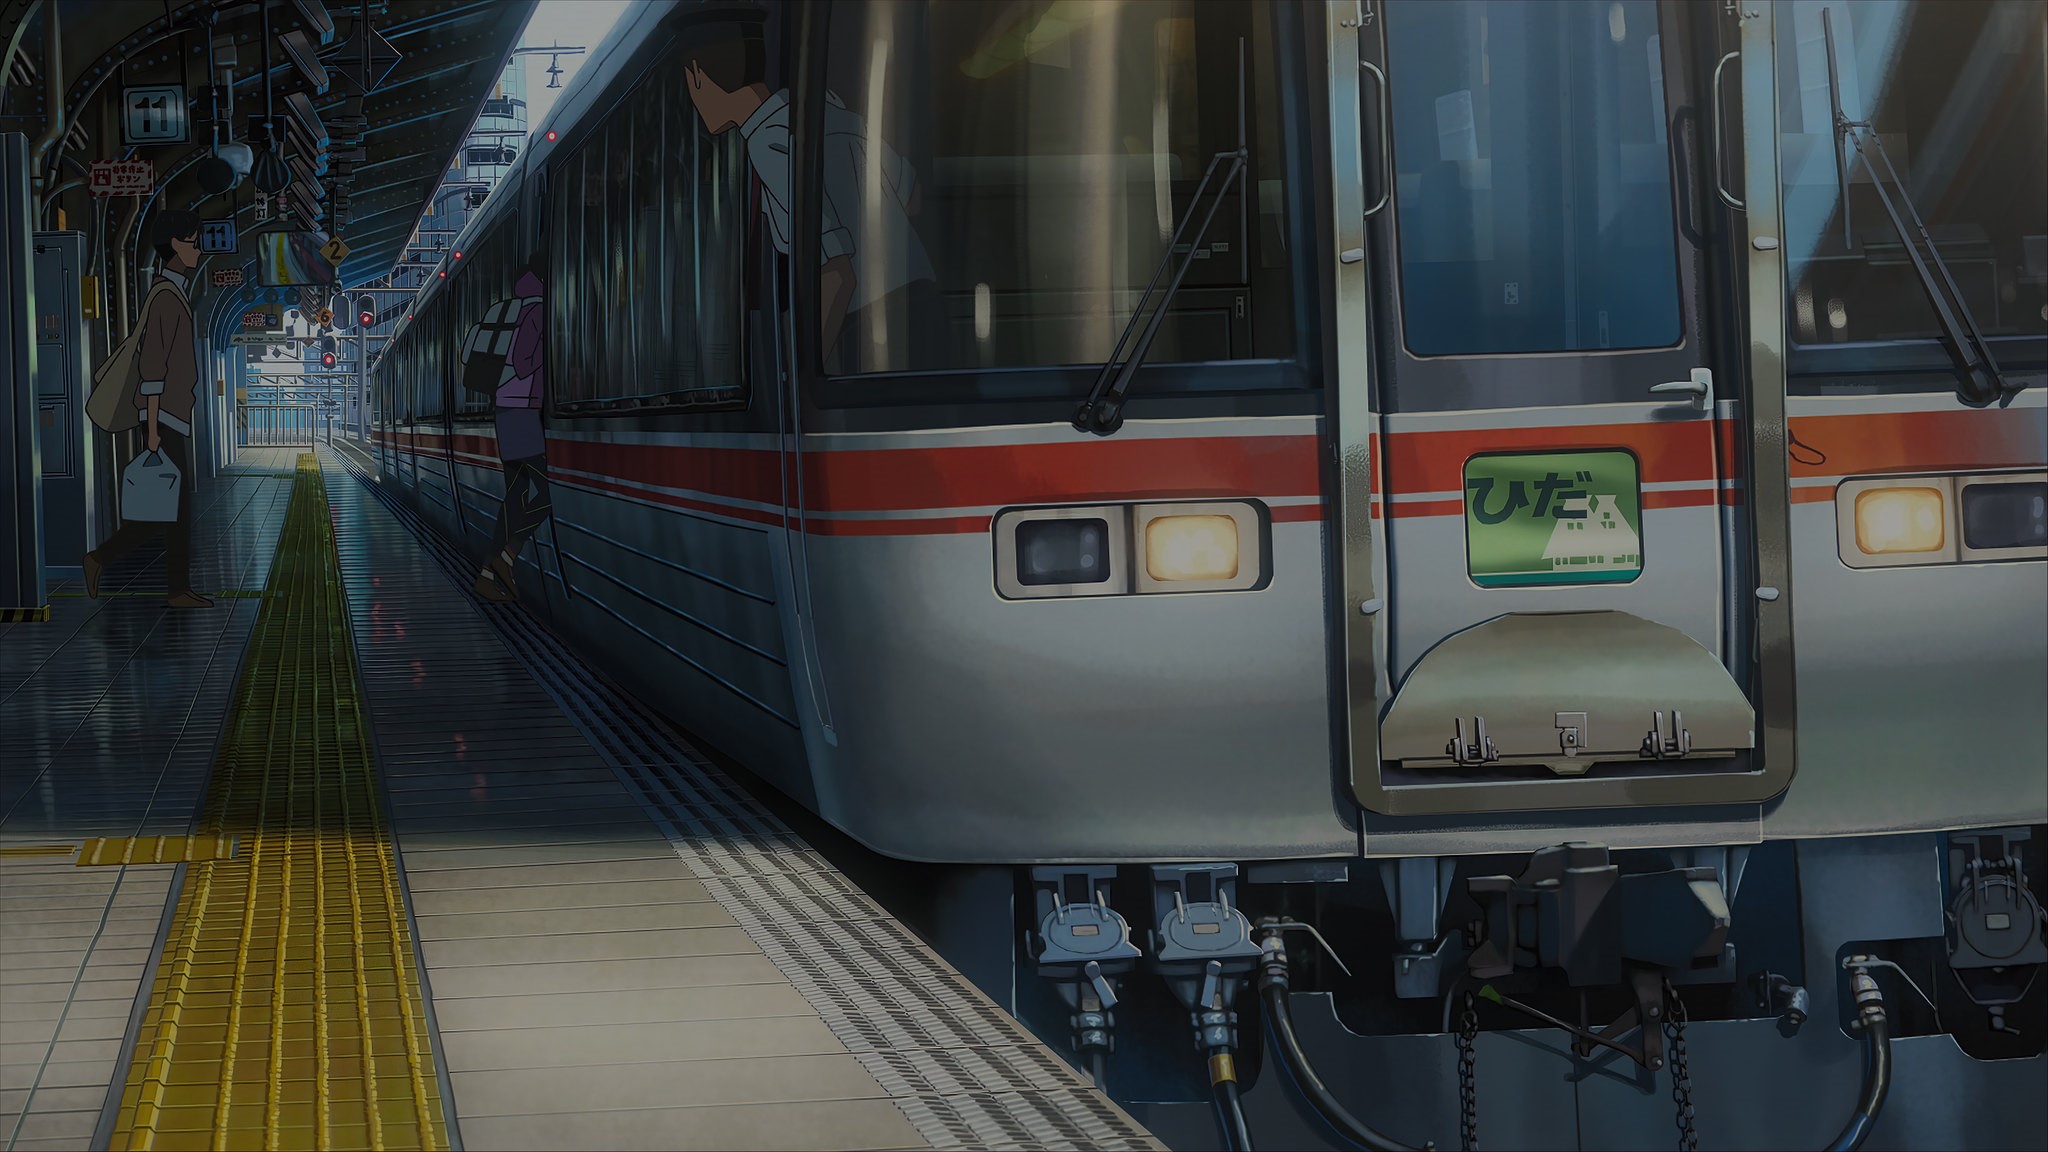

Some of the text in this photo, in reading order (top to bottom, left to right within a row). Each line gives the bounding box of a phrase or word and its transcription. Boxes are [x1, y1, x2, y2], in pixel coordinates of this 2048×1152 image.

[135, 96, 168, 132] 11
[206, 226, 226, 248] 11
[329, 241, 342, 259] 2
[1467, 471, 1593, 525] ひだ
